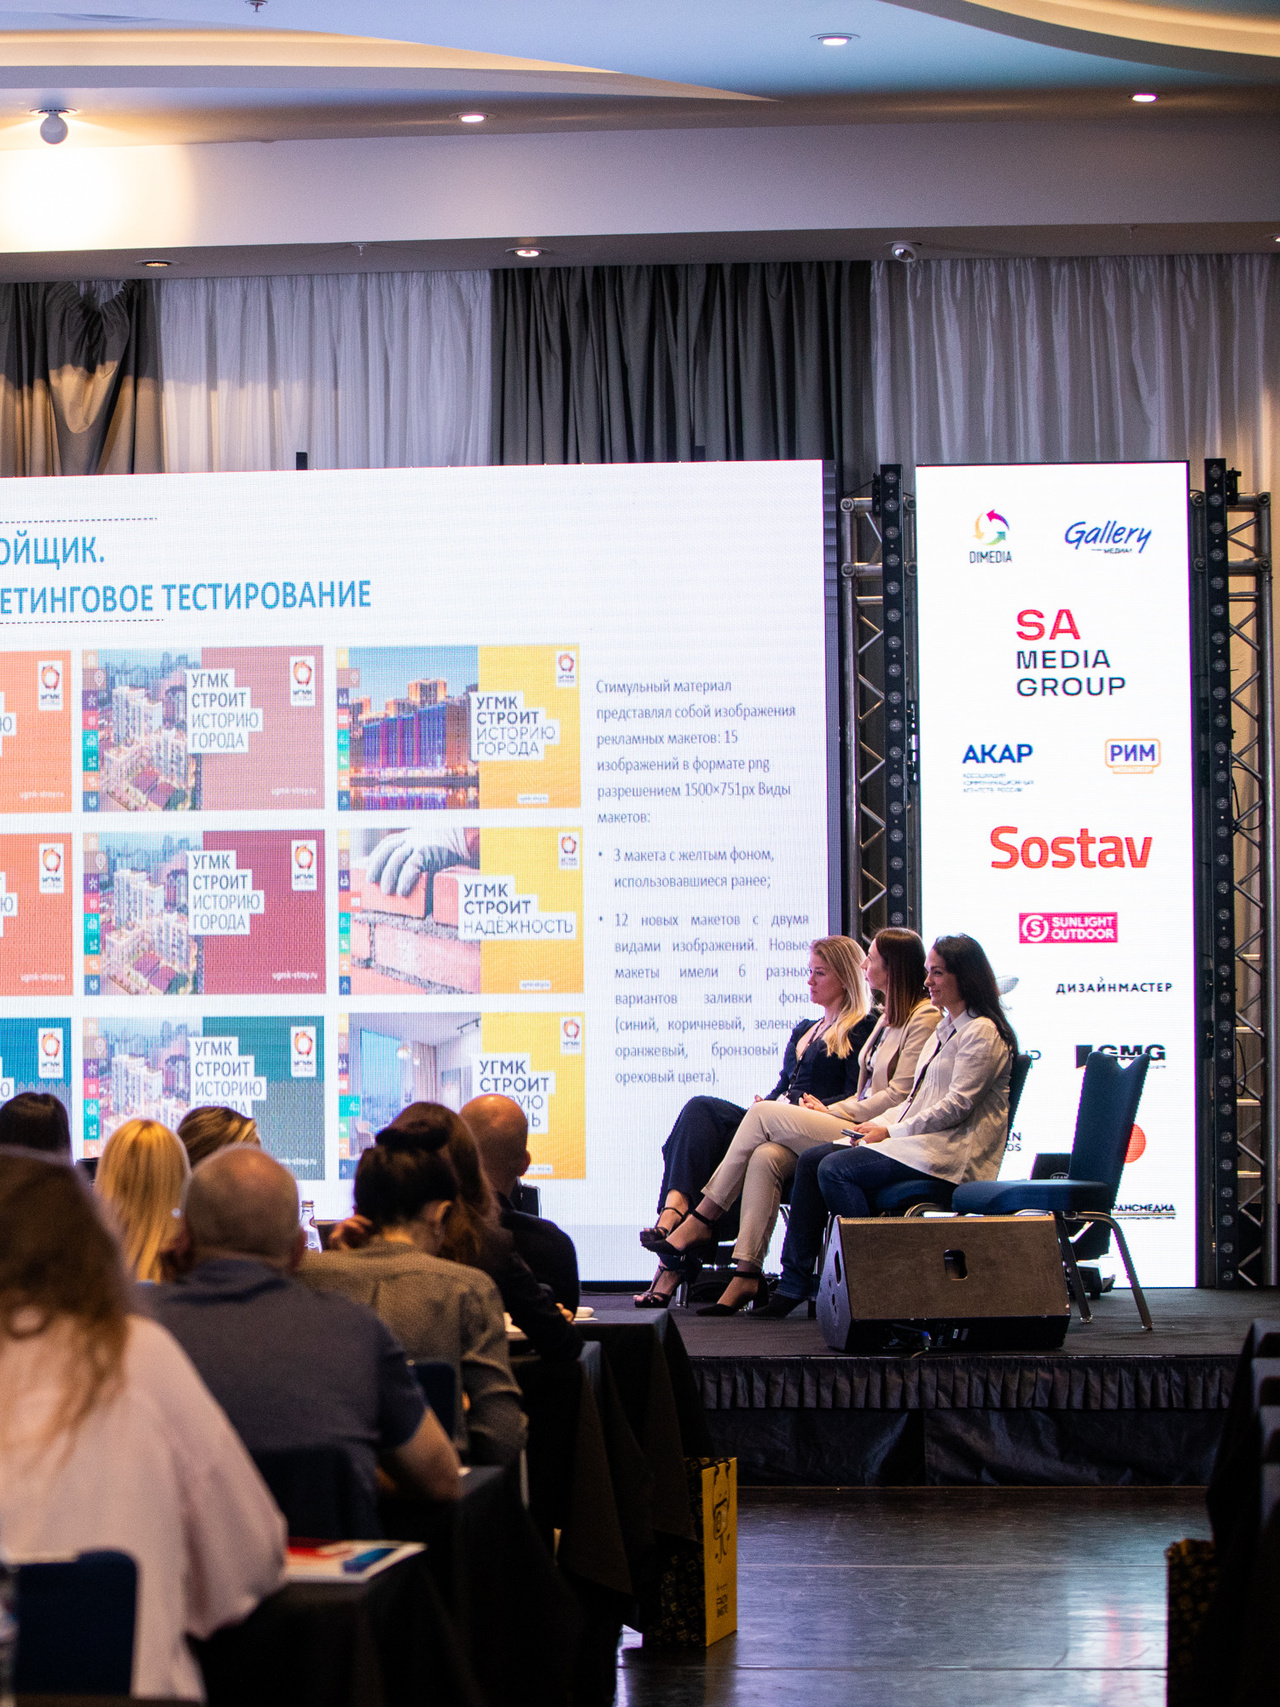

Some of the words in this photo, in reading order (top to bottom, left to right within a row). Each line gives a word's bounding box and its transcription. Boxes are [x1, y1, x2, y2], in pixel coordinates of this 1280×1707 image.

[1064, 520, 1152, 554] Gallery
[969, 550, 1012, 564] DIMEDIA
[161, 579, 372, 612] ТЕСТИРОВАНИЕ
[1016, 608, 1081, 641] SA
[1016, 649, 1111, 669] MEDIA
[192, 673, 229, 688] УГМК
[596, 679, 671, 696] Стимульный
[673, 680, 732, 695] материал
[1016, 676, 1126, 697] GROUP
[192, 692, 246, 708] СТРОИТ
[476, 696, 518, 710] УГМК
[192, 712, 259, 729] ИСТОРИЮ
[476, 711, 539, 725] СТРОИТ
[596, 707, 672, 722] представлял
[674, 703, 711, 719] собой
[714, 703, 796, 720] изображения
[192, 732, 245, 749] ГОРОДА
[476, 726, 556, 740] ИСТОРИЮ
[596, 733, 664, 748] рекламных
[667, 732, 720, 745] макетов:
[724, 730, 738, 744] 15
[476, 742, 539, 756] ГОРОДА
[962, 743, 1034, 764] АКАР
[1110, 743, 1156, 762] РИМ
[597, 757, 679, 774] изображений
[682, 760, 690, 770] в
[692, 756, 745, 773] формате
[748, 758, 770, 773] png
[597, 785, 681, 800] разрешением
[758, 781, 791, 798] Виды
[597, 812, 651, 824] макетов:
[613, 848, 621, 862] 3
[623, 850, 666, 862] макета
[669, 850, 675, 861] с
[678, 849, 727, 861] желтым
[729, 846, 774, 864] фоном,
[990, 825, 1153, 870] Sostav
[193, 854, 230, 869] УГМК
[193, 874, 248, 890] СТРОИТ
[614, 875, 727, 888] использовавшиеся
[731, 876, 771, 890] ранее;
[464, 883, 508, 898] УГМК
[193, 894, 260, 910] ИСТОРИЮ
[464, 900, 531, 915] СТРОИТ
[193, 914, 246, 930] ГОРОДА
[464, 916, 573, 935] НАДЁЖНОСТЬ
[615, 913, 629, 927] 12
[641, 915, 679, 926] новых
[690, 914, 741, 926] макетов
[752, 915, 759, 925] с
[771, 914, 809, 928] двумя
[1051, 916, 1114, 928] SUNLIGHT
[1051, 928, 1115, 940] OUTDOOR
[615, 941, 661, 955] видами
[672, 938, 758, 955] изображений.
[769, 938, 809, 951] Новые
[615, 967, 660, 979] макеты
[679, 966, 718, 978] имели
[738, 964, 746, 978] 6
[766, 966, 810, 980] разных
[1055, 976, 1173, 995] ДИЗАЙНМАСТЕР
[615, 993, 678, 1008] вариантов
[704, 992, 752, 1005] заливки
[778, 989, 810, 1006] фона
[615, 1016, 659, 1034] (синий,
[667, 1017, 745, 1033] коричневый,
[195, 1041, 232, 1056] УГМК
[615, 1043, 688, 1060] оранжевый,
[711, 1042, 778, 1059] бронзовый
[195, 1061, 250, 1077] СТРОИТ
[479, 1060, 526, 1075] УГМК
[480, 1077, 549, 1092] СТРОИТ
[615, 1069, 674, 1086] ореховый
[678, 1068, 719, 1085] цвета).
[195, 1080, 262, 1096] ИСТОРИЮ
[1113, 1203, 1175, 1213] РАНСМЕДИА
